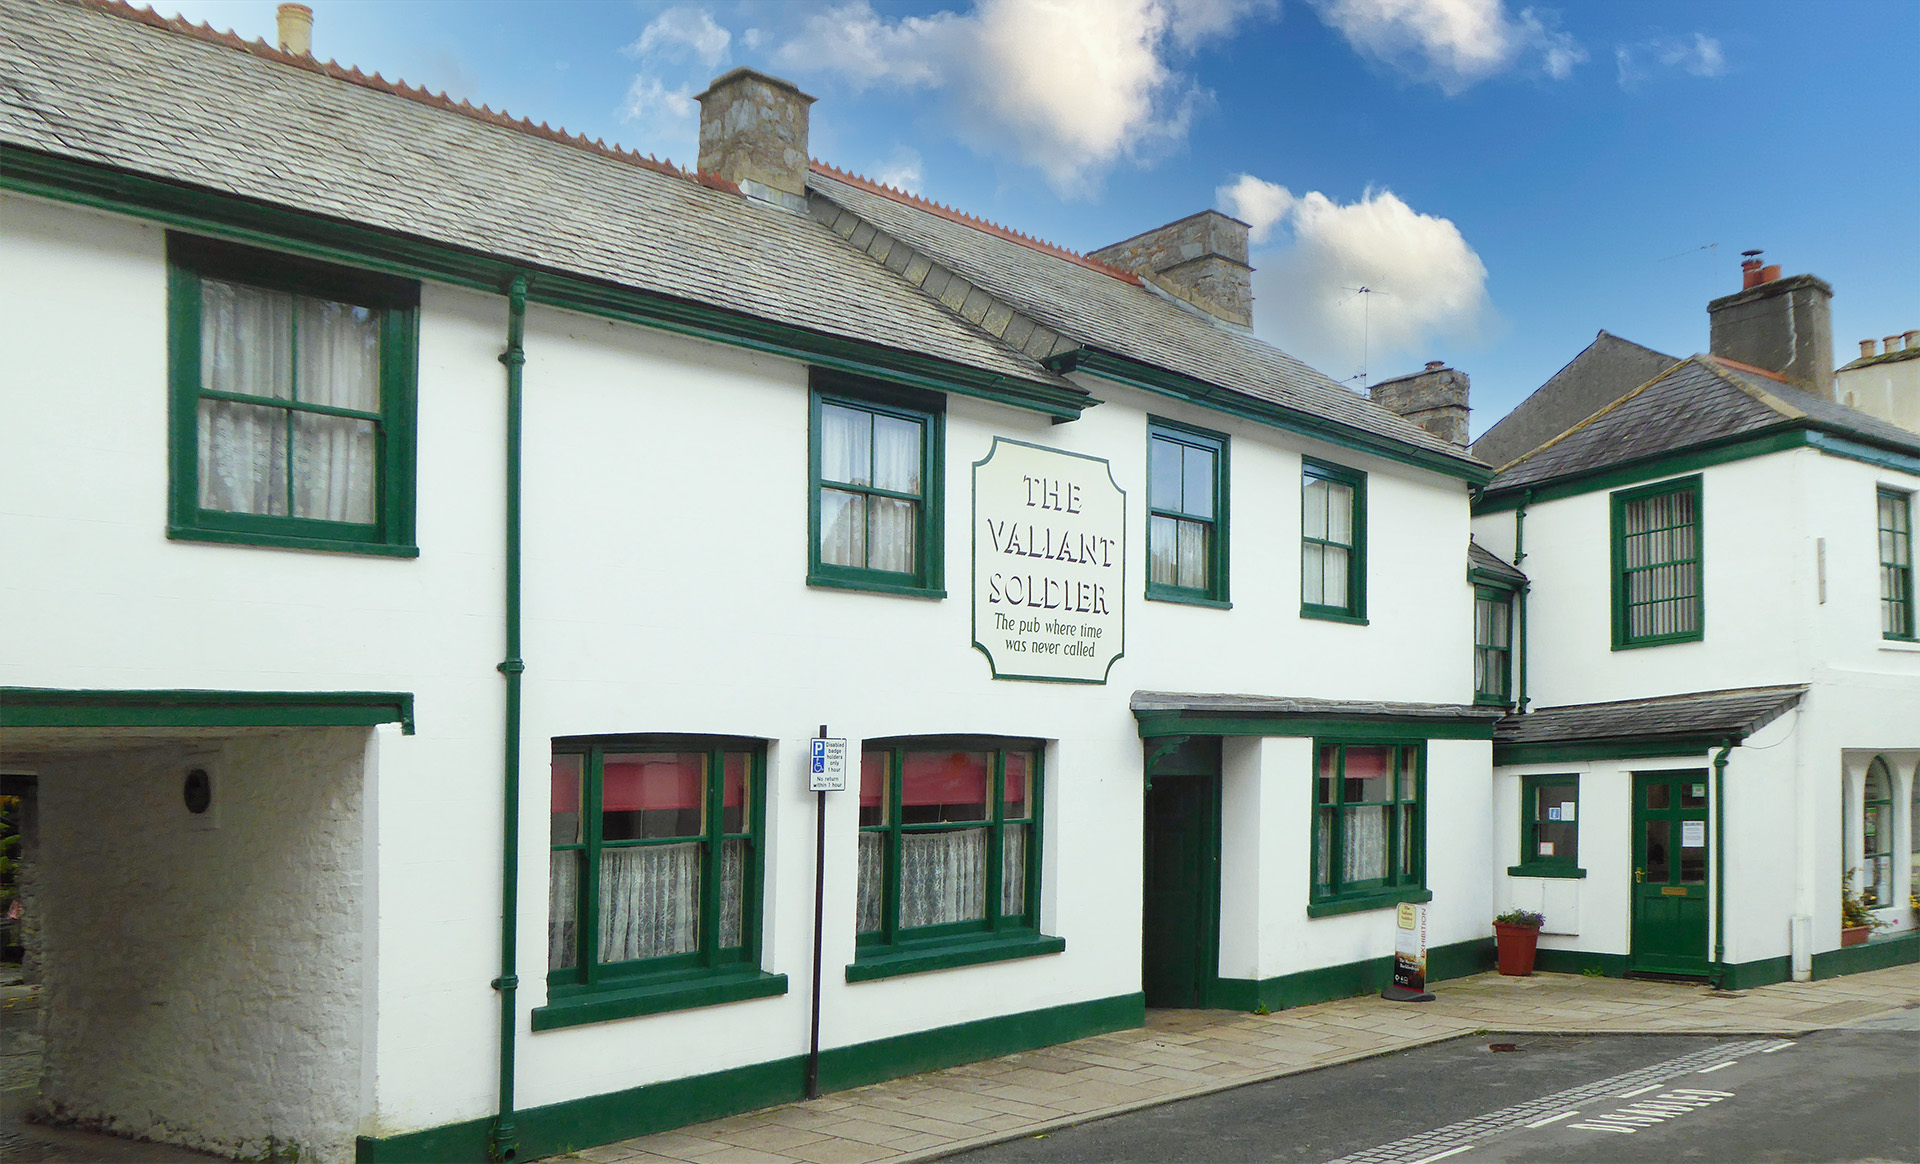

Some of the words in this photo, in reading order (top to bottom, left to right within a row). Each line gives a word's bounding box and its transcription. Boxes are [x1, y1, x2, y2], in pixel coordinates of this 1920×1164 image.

[1023, 475, 1082, 514] THE
[987, 518, 1115, 567] VALIANT
[989, 573, 1109, 615] SOLDIER
[994, 612, 1015, 631] The
[1018, 617, 1040, 635] pub
[1045, 619, 1077, 636] where
[1080, 623, 1103, 639] time
[1005, 639, 1027, 653] was
[1031, 641, 1061, 655] never
[1063, 641, 1096, 657] called
[815, 742, 823, 755] P
[1566, 1089, 1737, 1134] DISABLED
